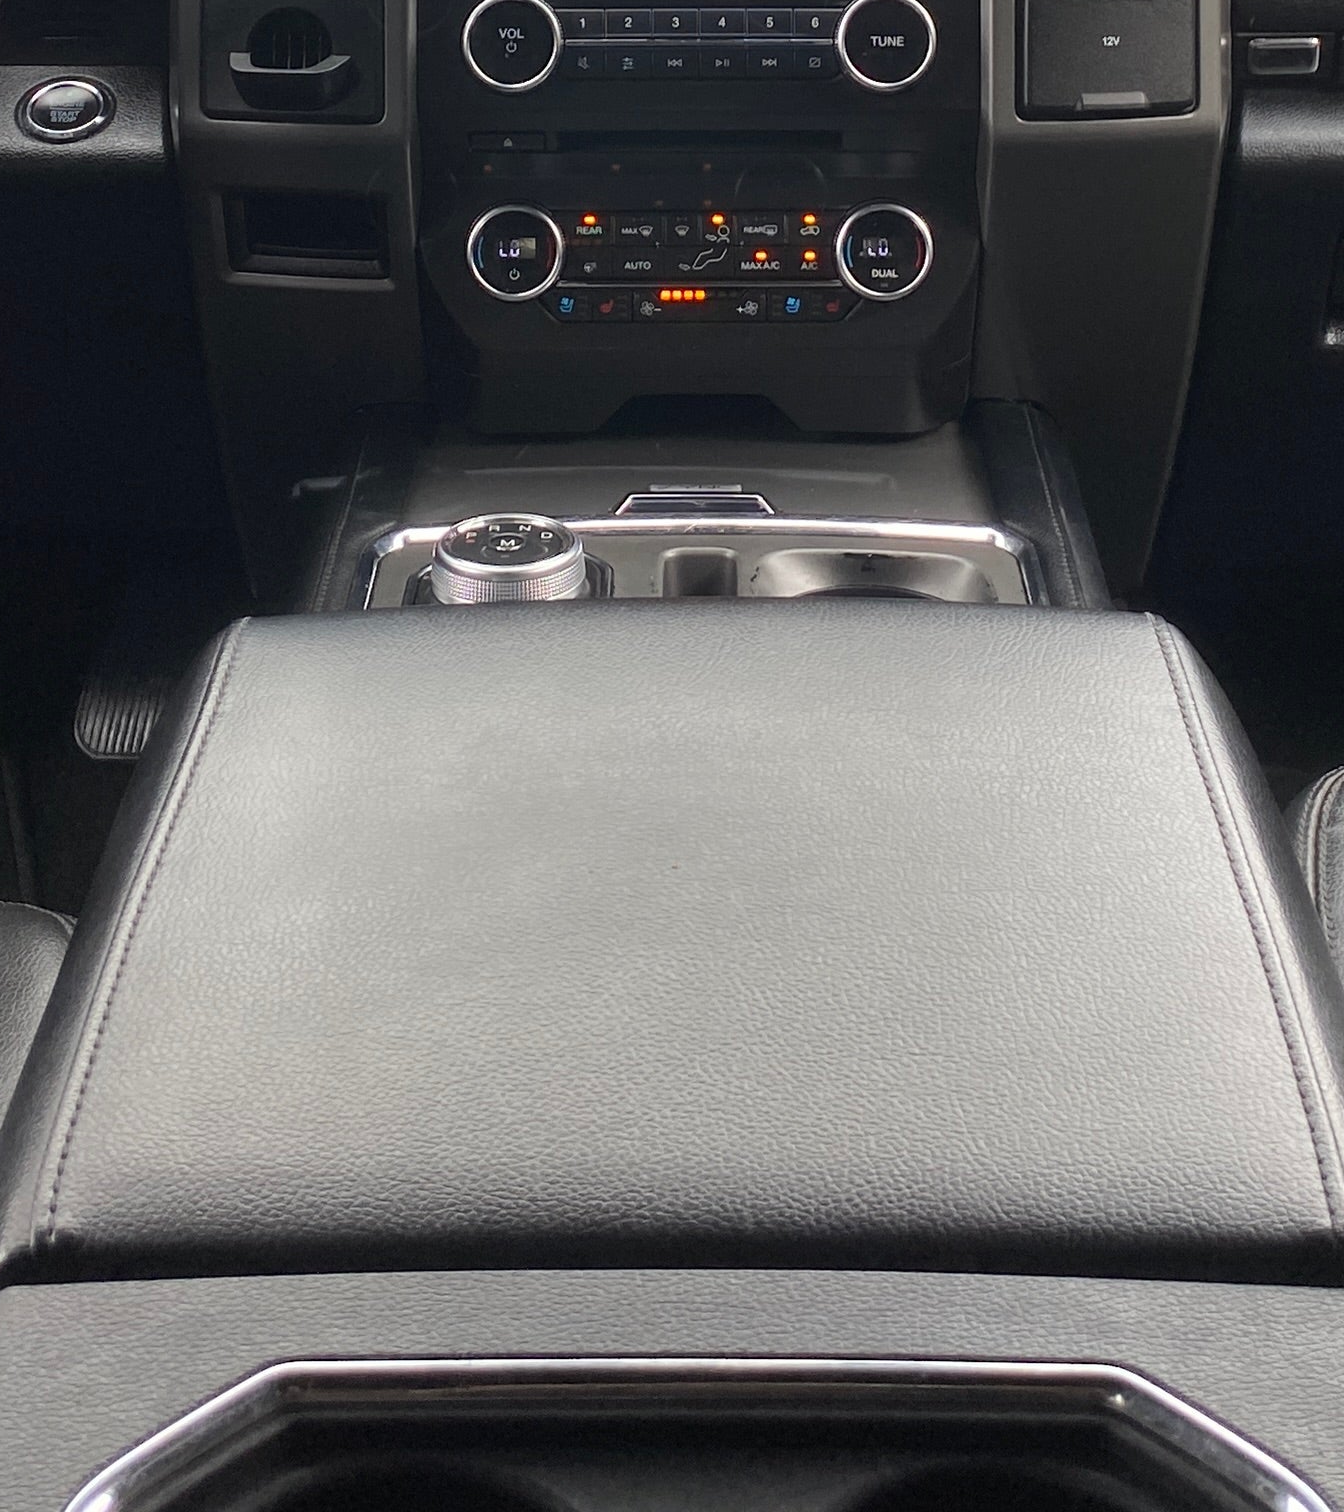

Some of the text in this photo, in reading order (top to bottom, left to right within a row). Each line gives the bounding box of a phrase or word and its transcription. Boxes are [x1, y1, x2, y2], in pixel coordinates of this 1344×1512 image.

[579, 17, 586, 29] 1
[624, 17, 632, 28] 2
[671, 17, 680, 28] 3
[718, 17, 726, 28] 4
[766, 17, 774, 28] 5
[811, 17, 819, 28] 6
[499, 28, 524, 39] VOL
[870, 35, 905, 47] TUNE
[1102, 35, 1120, 46] 12V
[576, 226, 603, 235] REAR
[621, 227, 638, 235] MAX
[743, 226, 763, 234] REAR
[624, 261, 652, 270] AUTO
[800, 261, 819, 270] A/C
[871, 269, 899, 278] DUAL
